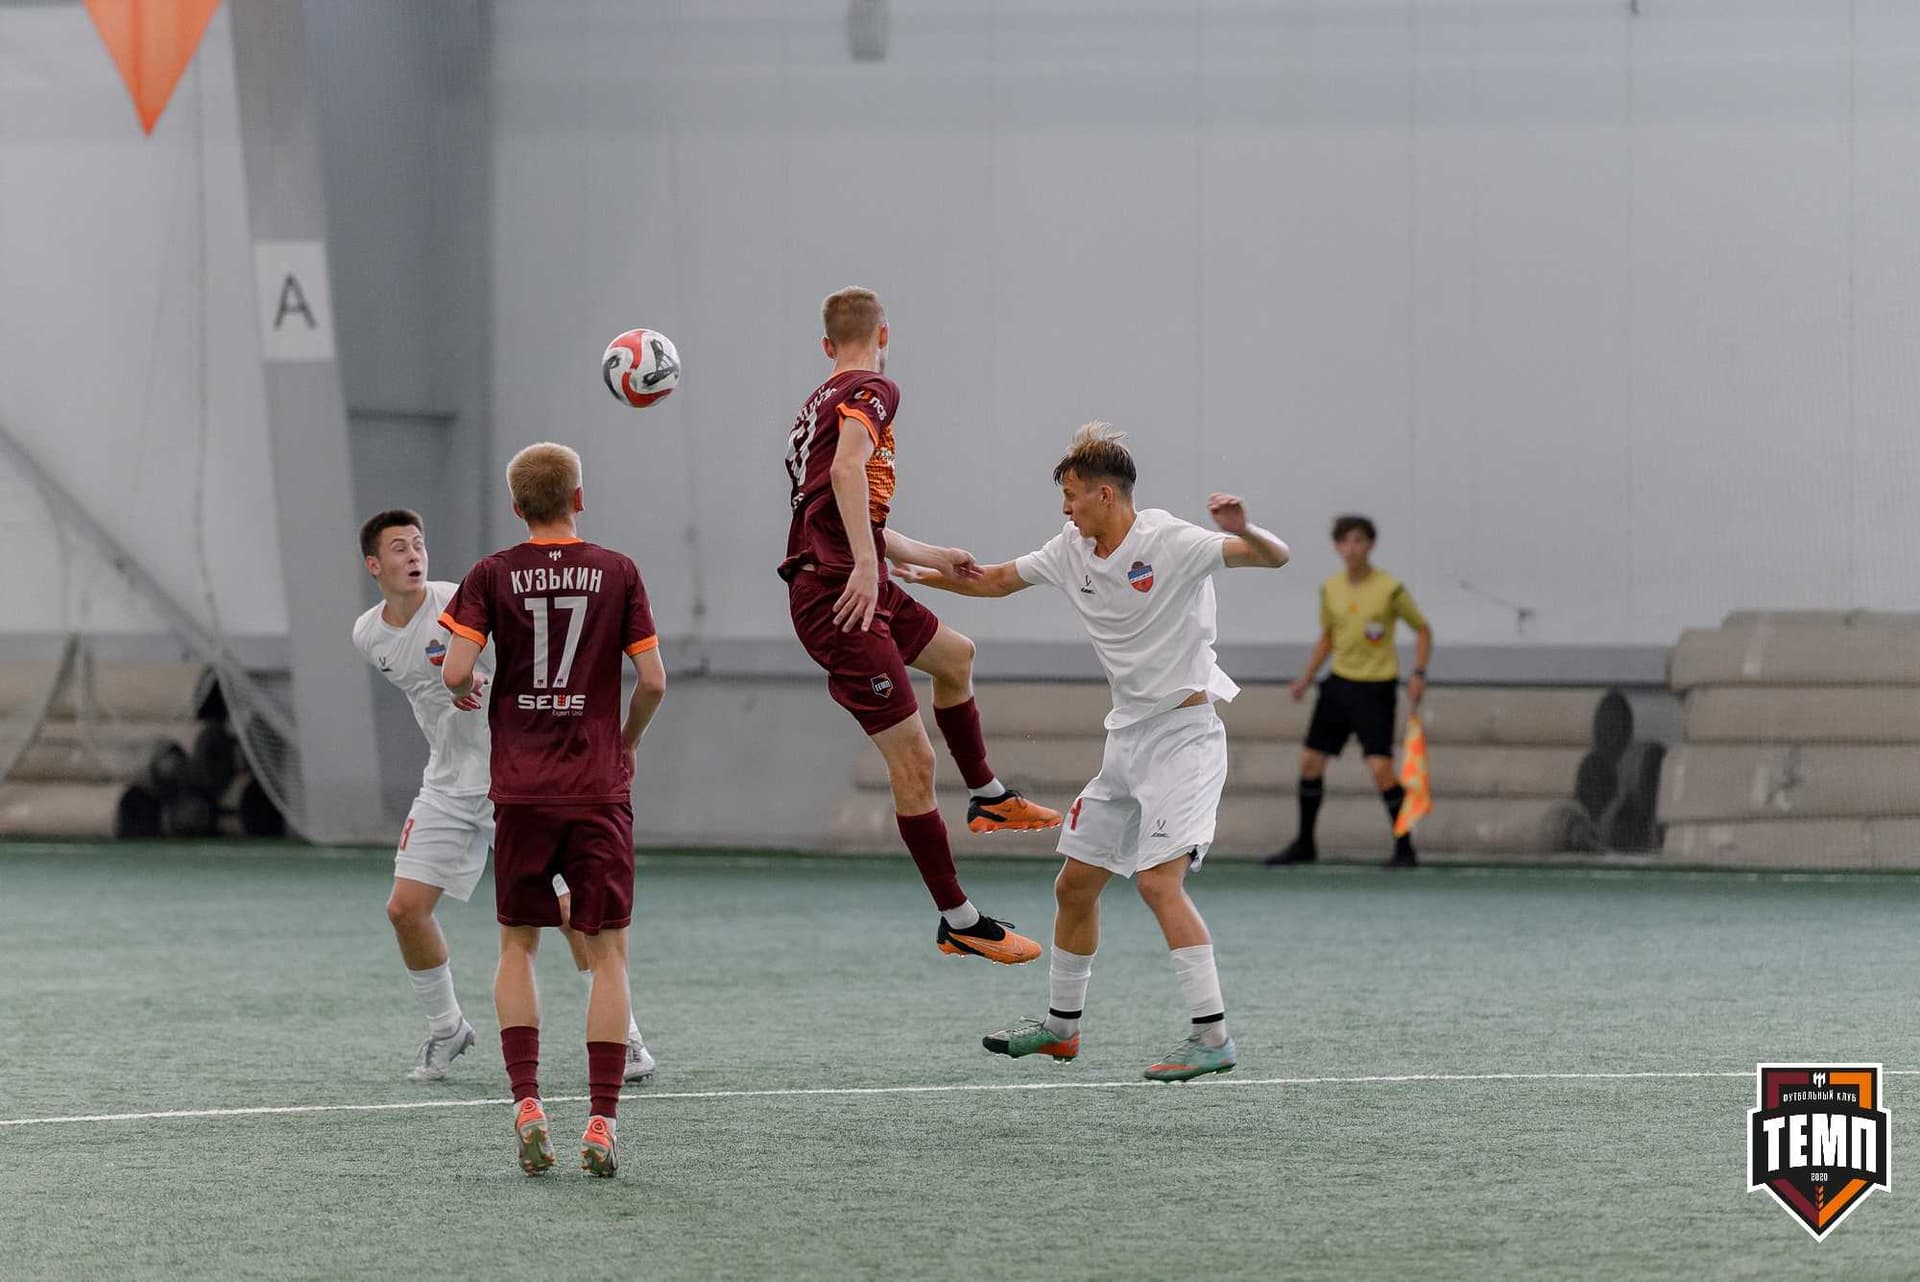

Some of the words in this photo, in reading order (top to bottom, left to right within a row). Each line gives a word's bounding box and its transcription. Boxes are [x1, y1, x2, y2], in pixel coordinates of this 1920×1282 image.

[511, 567, 602, 594] КУЗЬКИН
[524, 596, 588, 688] 17
[518, 694, 586, 709] SEUS
